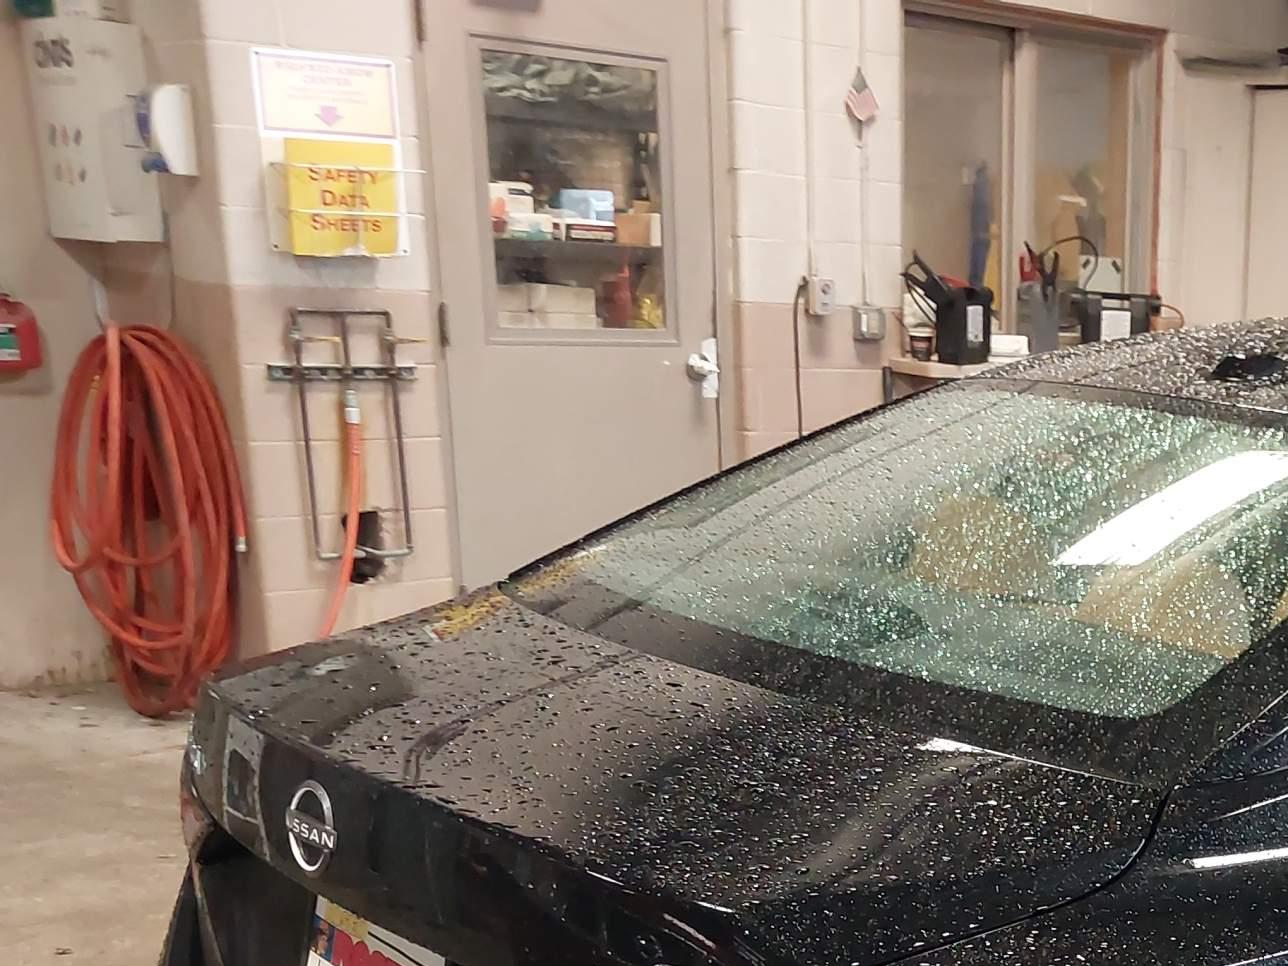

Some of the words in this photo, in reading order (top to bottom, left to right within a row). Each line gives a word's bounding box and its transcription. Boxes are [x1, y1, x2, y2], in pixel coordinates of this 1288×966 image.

[308, 165, 379, 185] SAFETY
[320, 189, 370, 208] DATA
[311, 213, 383, 233] SHEETS
[289, 816, 335, 850] SSAN
